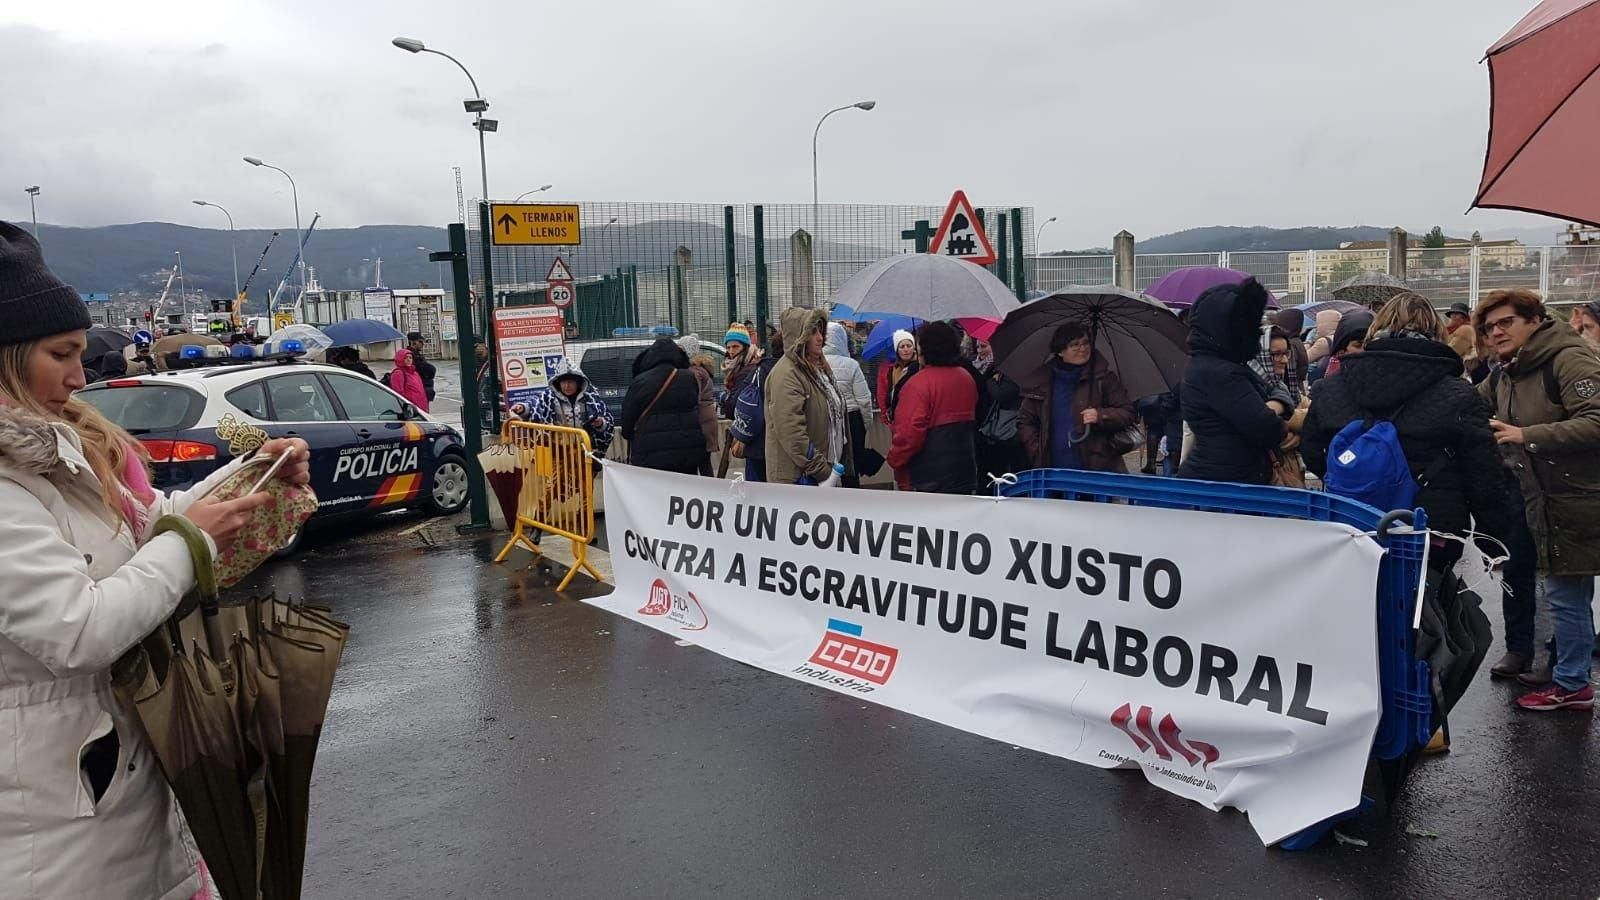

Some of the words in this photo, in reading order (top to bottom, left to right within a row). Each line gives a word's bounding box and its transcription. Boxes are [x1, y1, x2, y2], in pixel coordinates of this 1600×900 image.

[522, 211, 574, 223] TERMARÍN
[530, 227, 568, 238] LLENOS
[553, 290, 569, 300] 20
[503, 328, 540, 336] RESTRICTED
[340, 446, 365, 456] CUERPO
[365, 443, 392, 453] NACIONAL
[392, 442, 401, 450] DE
[332, 446, 419, 483] POLICIA
[666, 495, 725, 534] POR
[733, 503, 779, 542] UN
[788, 510, 993, 576] CONVENIO
[1005, 537, 1183, 610] XUSTO
[653, 586, 668, 609] UGT
[674, 595, 689, 612] FICA
[624, 528, 716, 581] CONTRA
[724, 552, 748, 588] A
[757, 556, 1029, 650] ESCRAVITUDE
[1045, 611, 1329, 726] LABORAL
[818, 640, 891, 678] CCOO
[792, 663, 876, 695] industria
